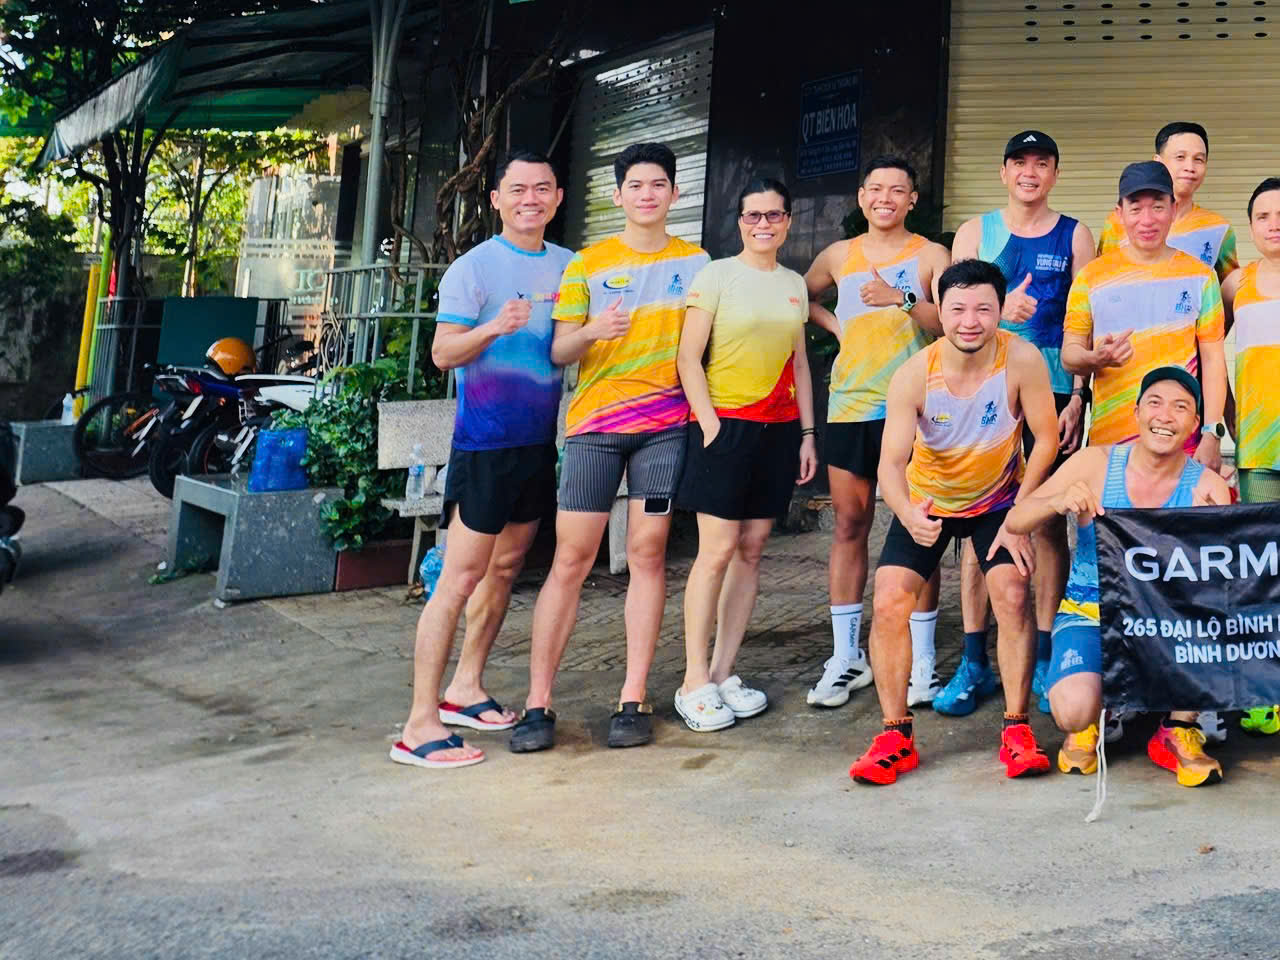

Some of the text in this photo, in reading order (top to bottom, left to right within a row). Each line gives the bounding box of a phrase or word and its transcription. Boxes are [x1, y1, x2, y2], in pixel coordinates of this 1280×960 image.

[1122, 617, 1157, 637] 265
[1160, 619, 1192, 642] ĐẠI
[1197, 616, 1221, 641] LỘ
[1226, 610, 1273, 636] BÌNH
[1175, 642, 1222, 664] BÌNH
